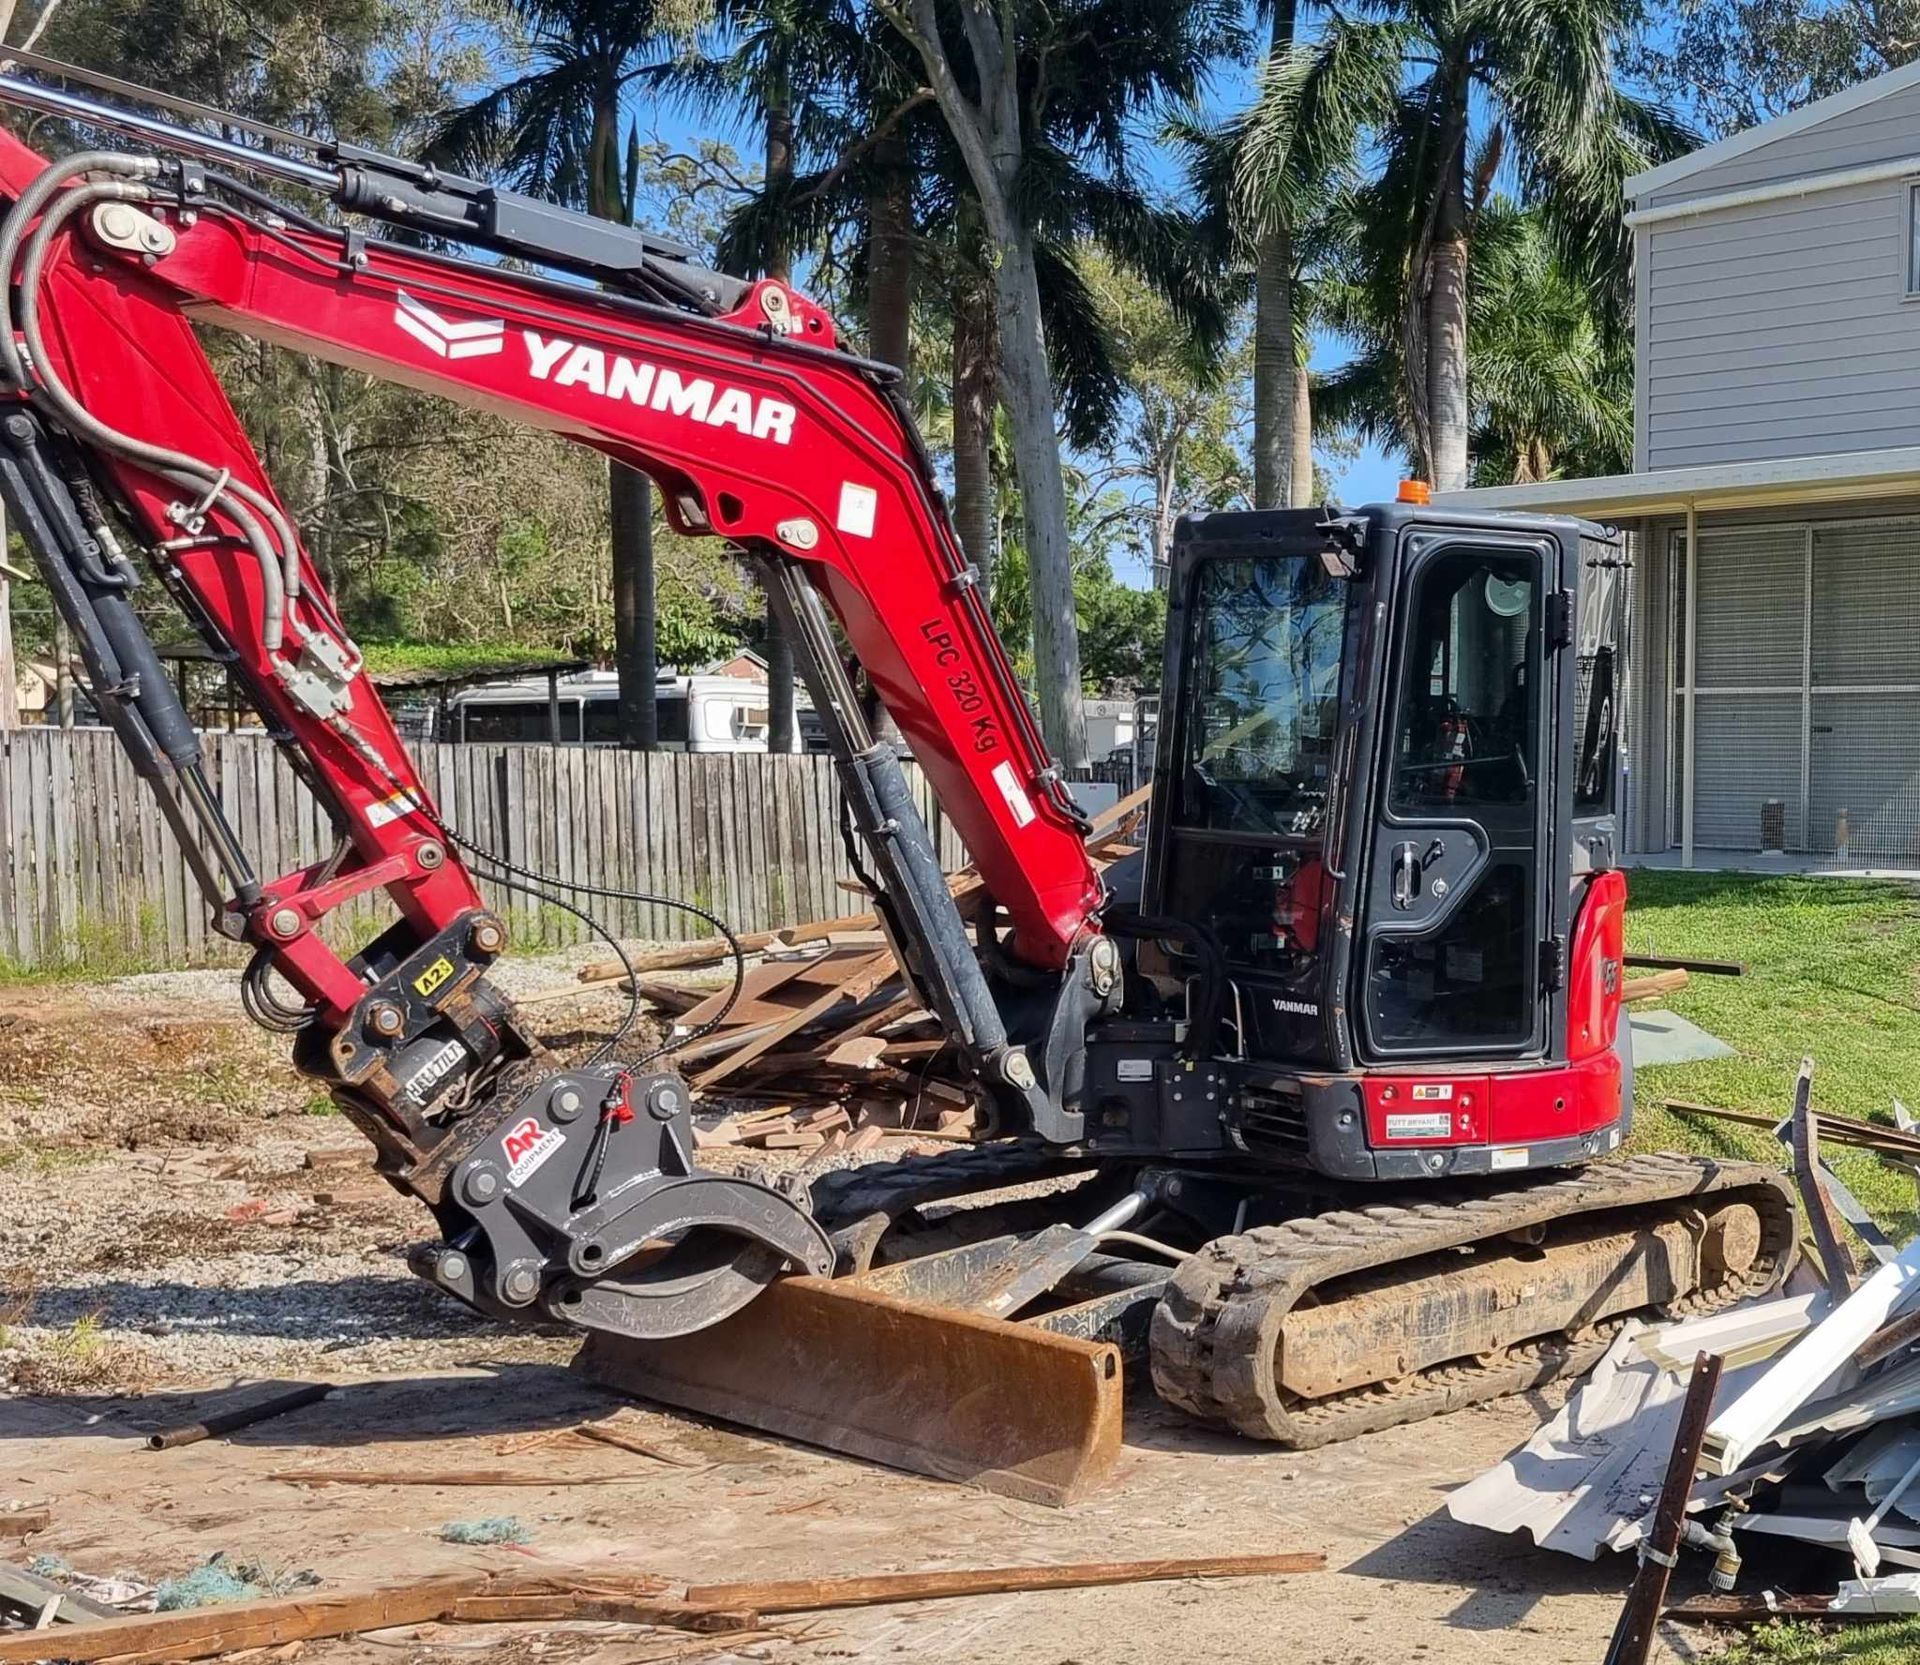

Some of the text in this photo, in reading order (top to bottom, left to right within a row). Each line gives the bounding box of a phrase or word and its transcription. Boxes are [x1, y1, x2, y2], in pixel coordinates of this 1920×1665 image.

[522, 330, 797, 445] YANMAR
[919, 618, 998, 753] LPC 320 Kg
[1272, 998, 1318, 1016] YANMAR
[505, 1120, 545, 1165] AR
[509, 1131, 560, 1181] EQUIPMENT
